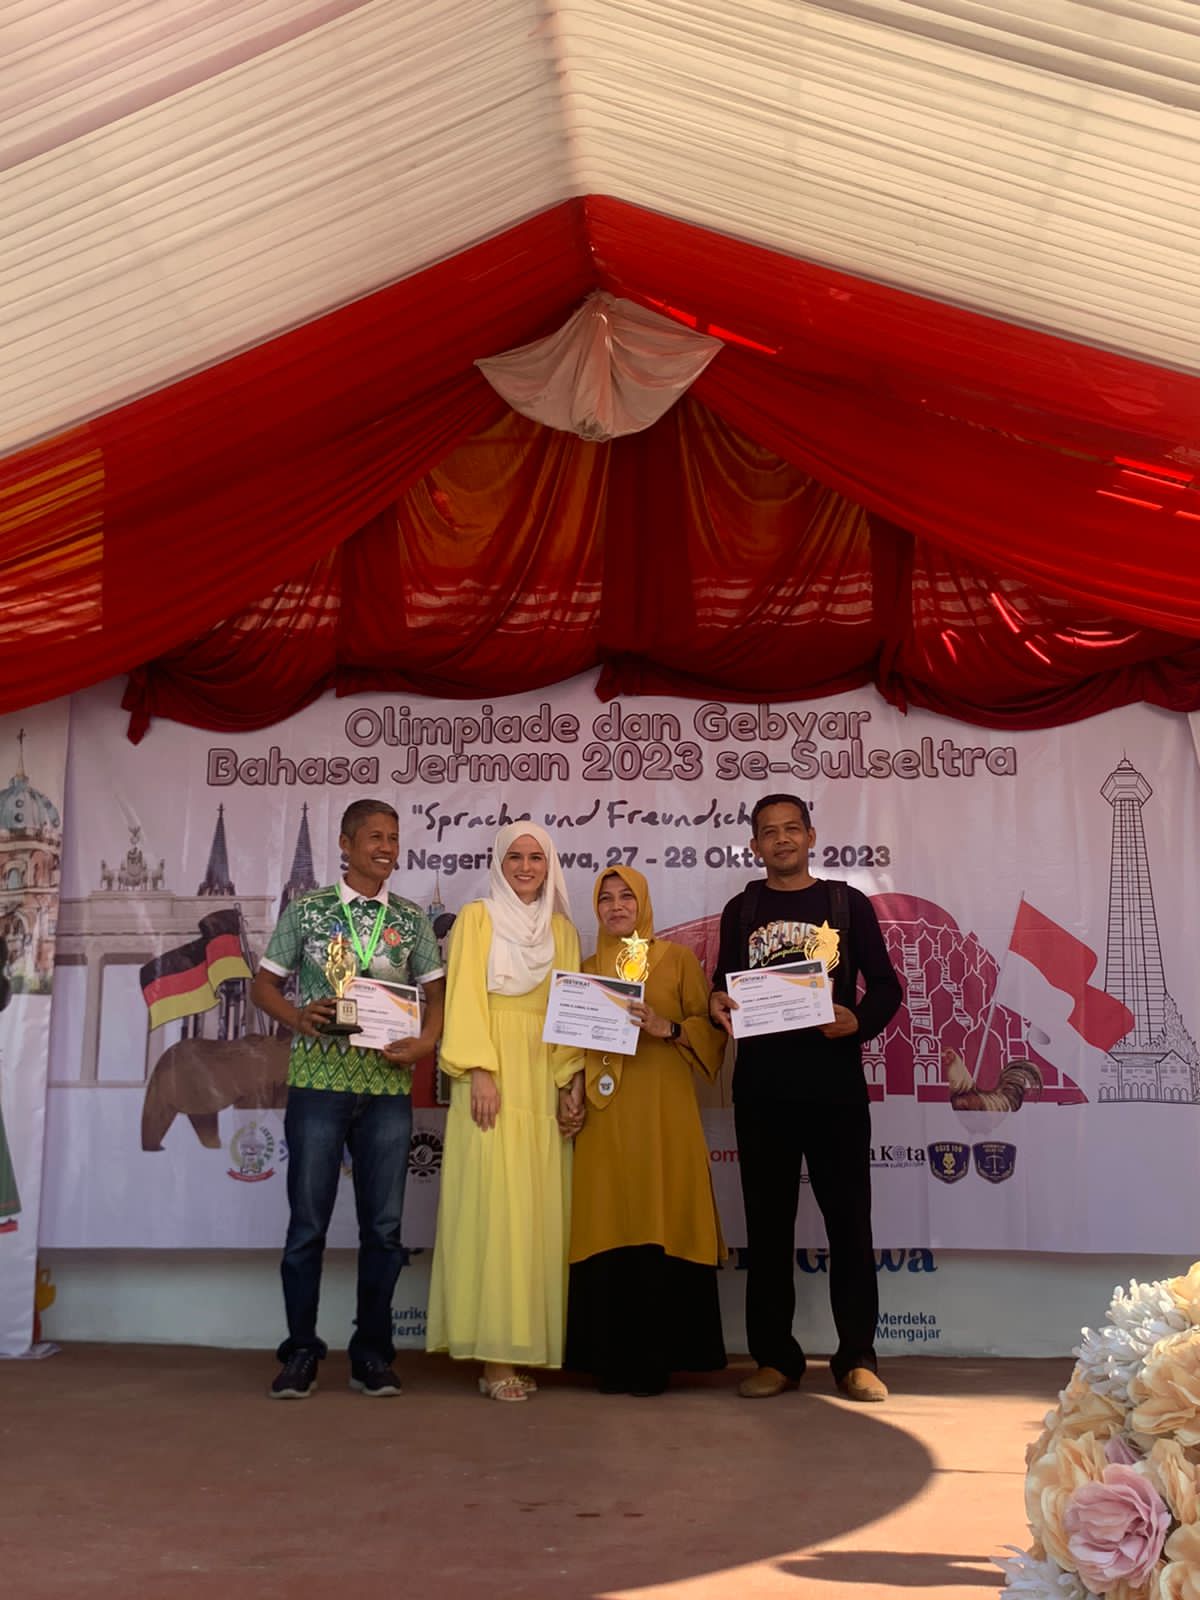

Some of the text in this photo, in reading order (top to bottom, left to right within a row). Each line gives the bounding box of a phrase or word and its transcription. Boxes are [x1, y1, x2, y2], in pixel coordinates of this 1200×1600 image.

[345, 702, 871, 755] Olimpiade dan Gebyar
[207, 736, 1018, 786] Bahasa Jerman 2023 se-Sulseltra
[545, 799, 600, 828] und
[407, 847, 493, 875] Negeri
[606, 846, 639, 868] 27
[664, 846, 697, 868] 28
[823, 845, 891, 868] 2023
[876, 1313, 937, 1325] Merdeka
[876, 1327, 942, 1342] Mengajar
